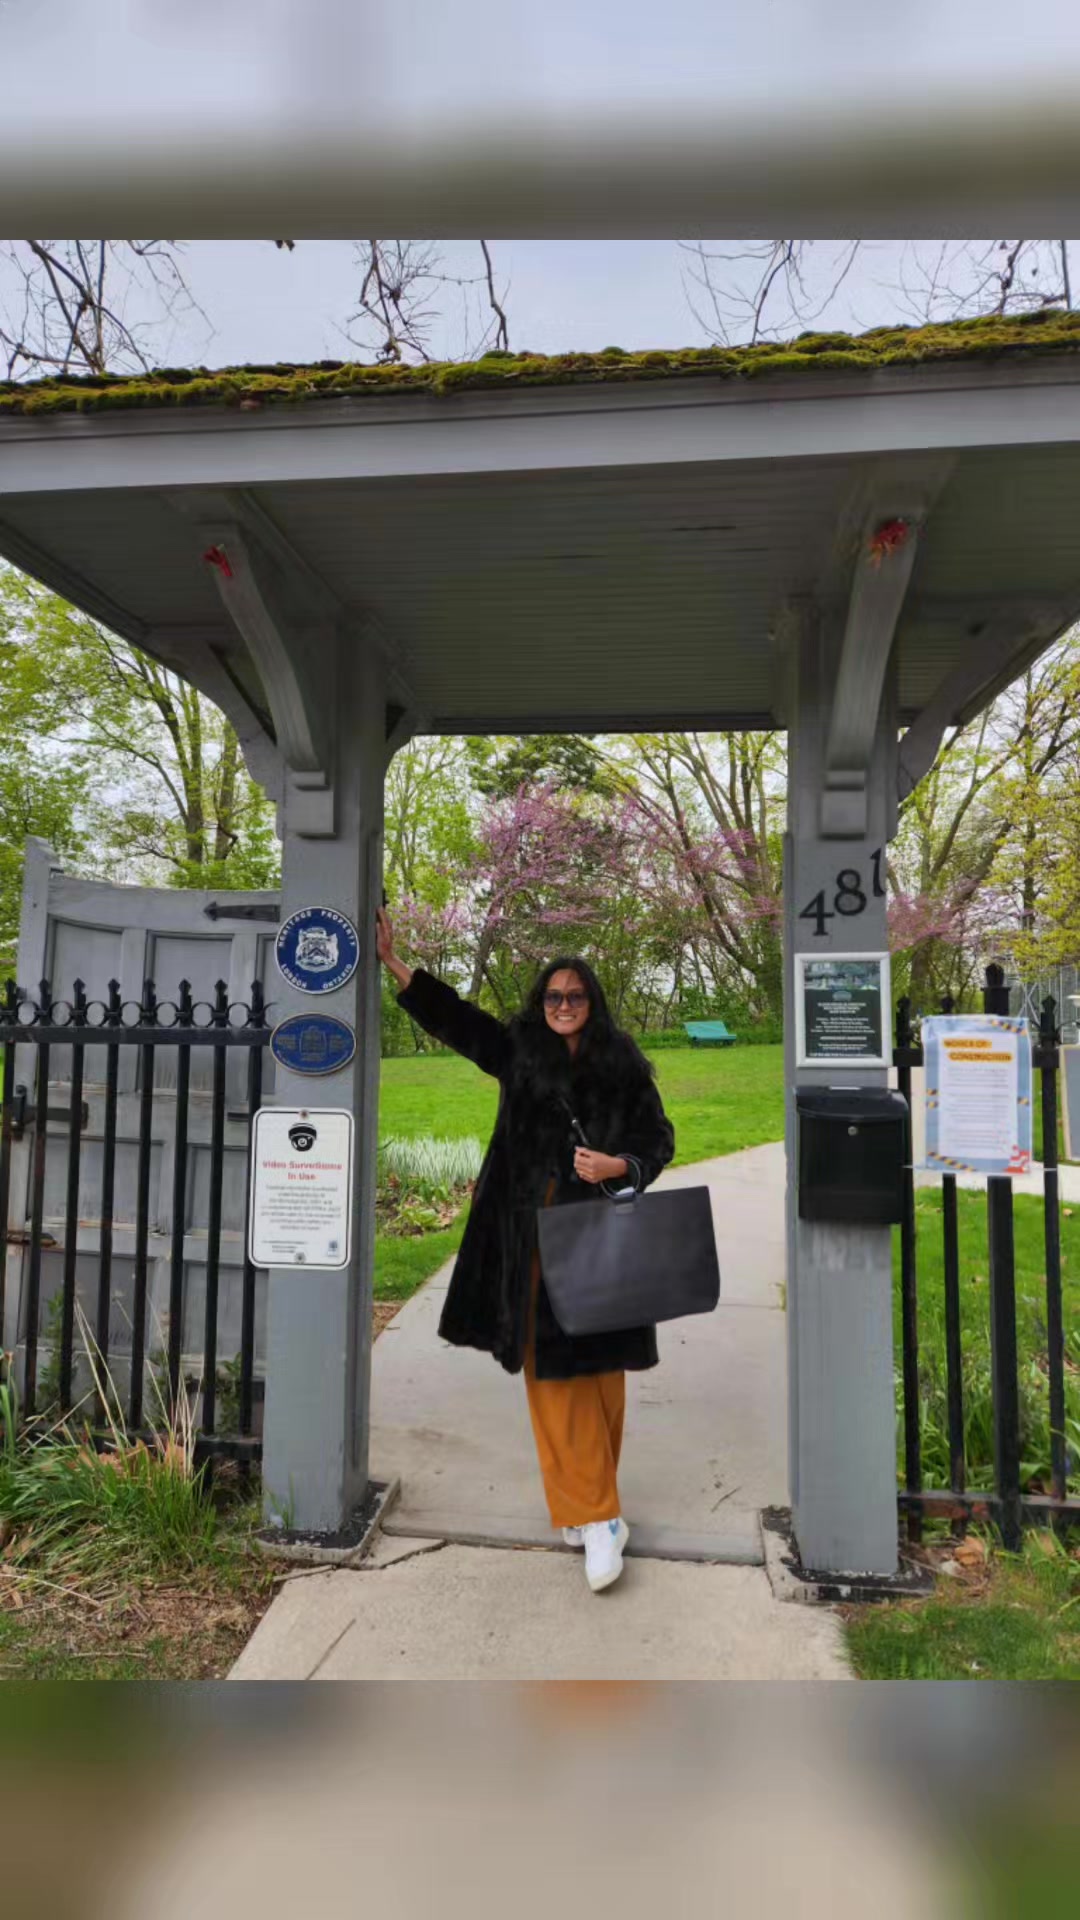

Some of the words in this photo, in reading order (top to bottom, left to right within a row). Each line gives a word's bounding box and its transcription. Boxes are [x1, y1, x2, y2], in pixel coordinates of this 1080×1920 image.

[798, 847, 886, 937] 481
[278, 910, 313, 948] HERITAGE
[320, 910, 357, 947] PROPERTY
[280, 963, 308, 989] LONDON
[321, 963, 353, 990] ONTARIO
[262, 1160, 287, 1169] Video
[288, 1172, 296, 1180] In
[299, 1172, 316, 1180] Use
